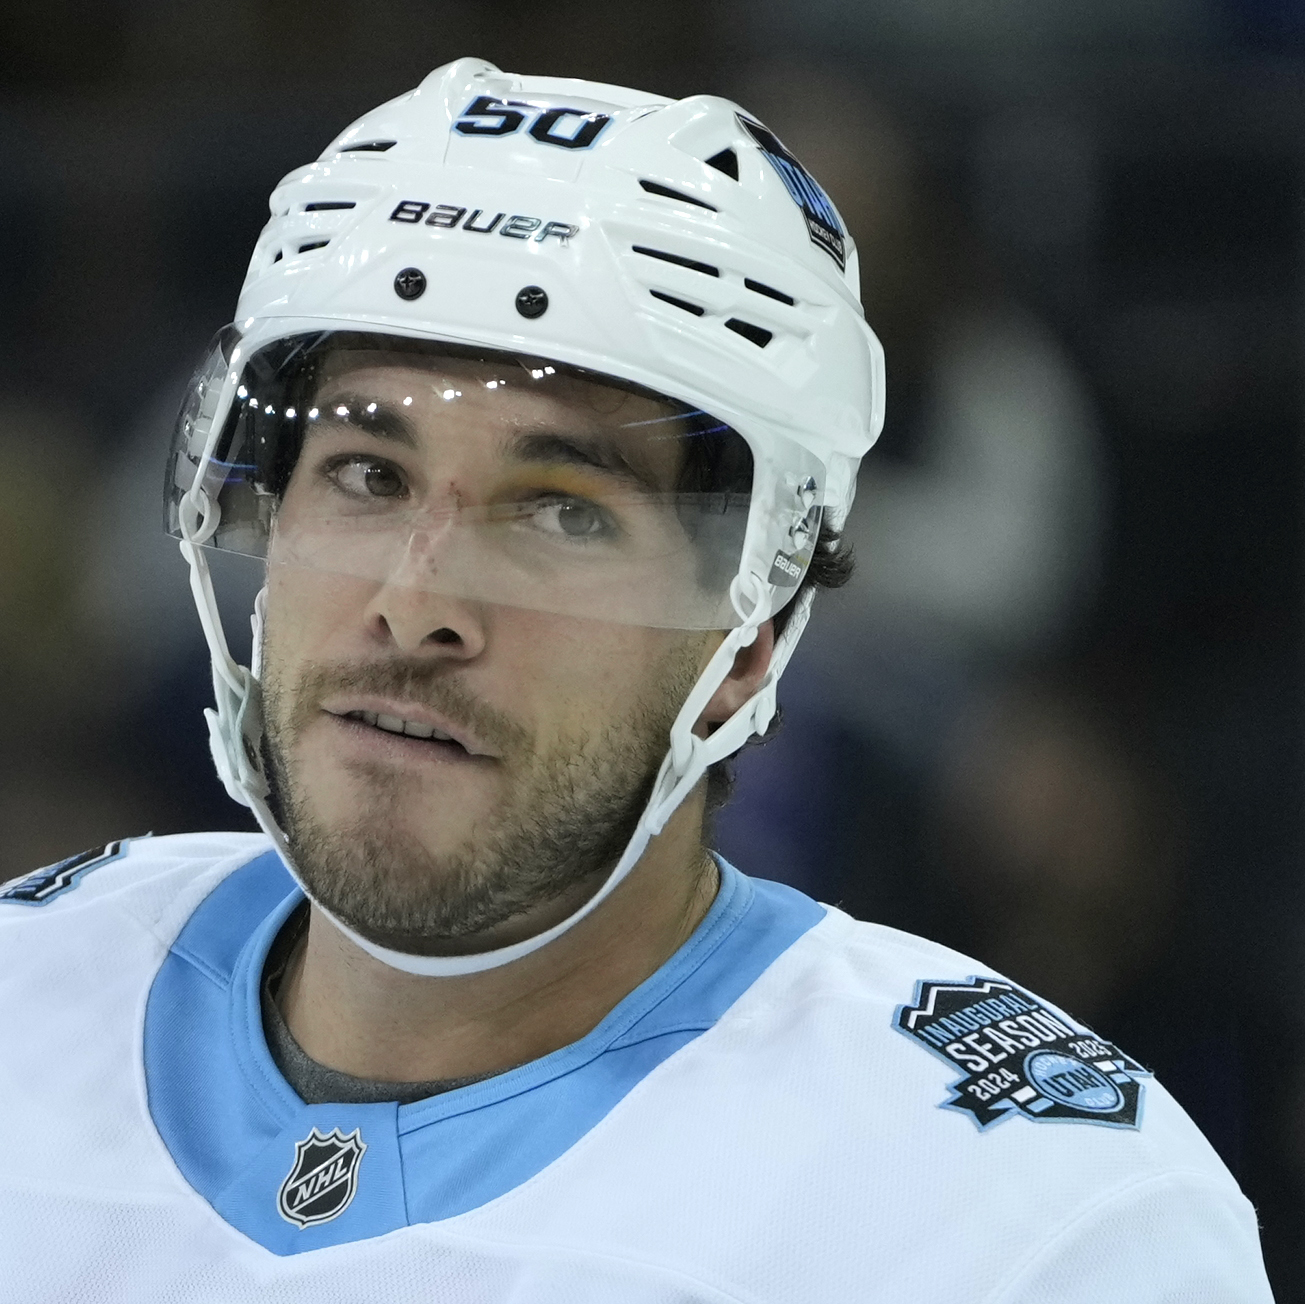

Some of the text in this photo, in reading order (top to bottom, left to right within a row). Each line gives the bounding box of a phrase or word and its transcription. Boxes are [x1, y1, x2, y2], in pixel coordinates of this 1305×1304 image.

[451, 95, 614, 151] 50
[389, 200, 579, 247] BAUER
[774, 554, 802, 579] BAUER
[917, 992, 1038, 1047] INAUGURAL
[946, 1009, 1076, 1072] SEASON
[1068, 1039, 1113, 1059] 2025
[967, 1067, 1021, 1101] 2024
[1042, 1067, 1108, 1097] UTAH
[293, 1156, 348, 1207] NHL
